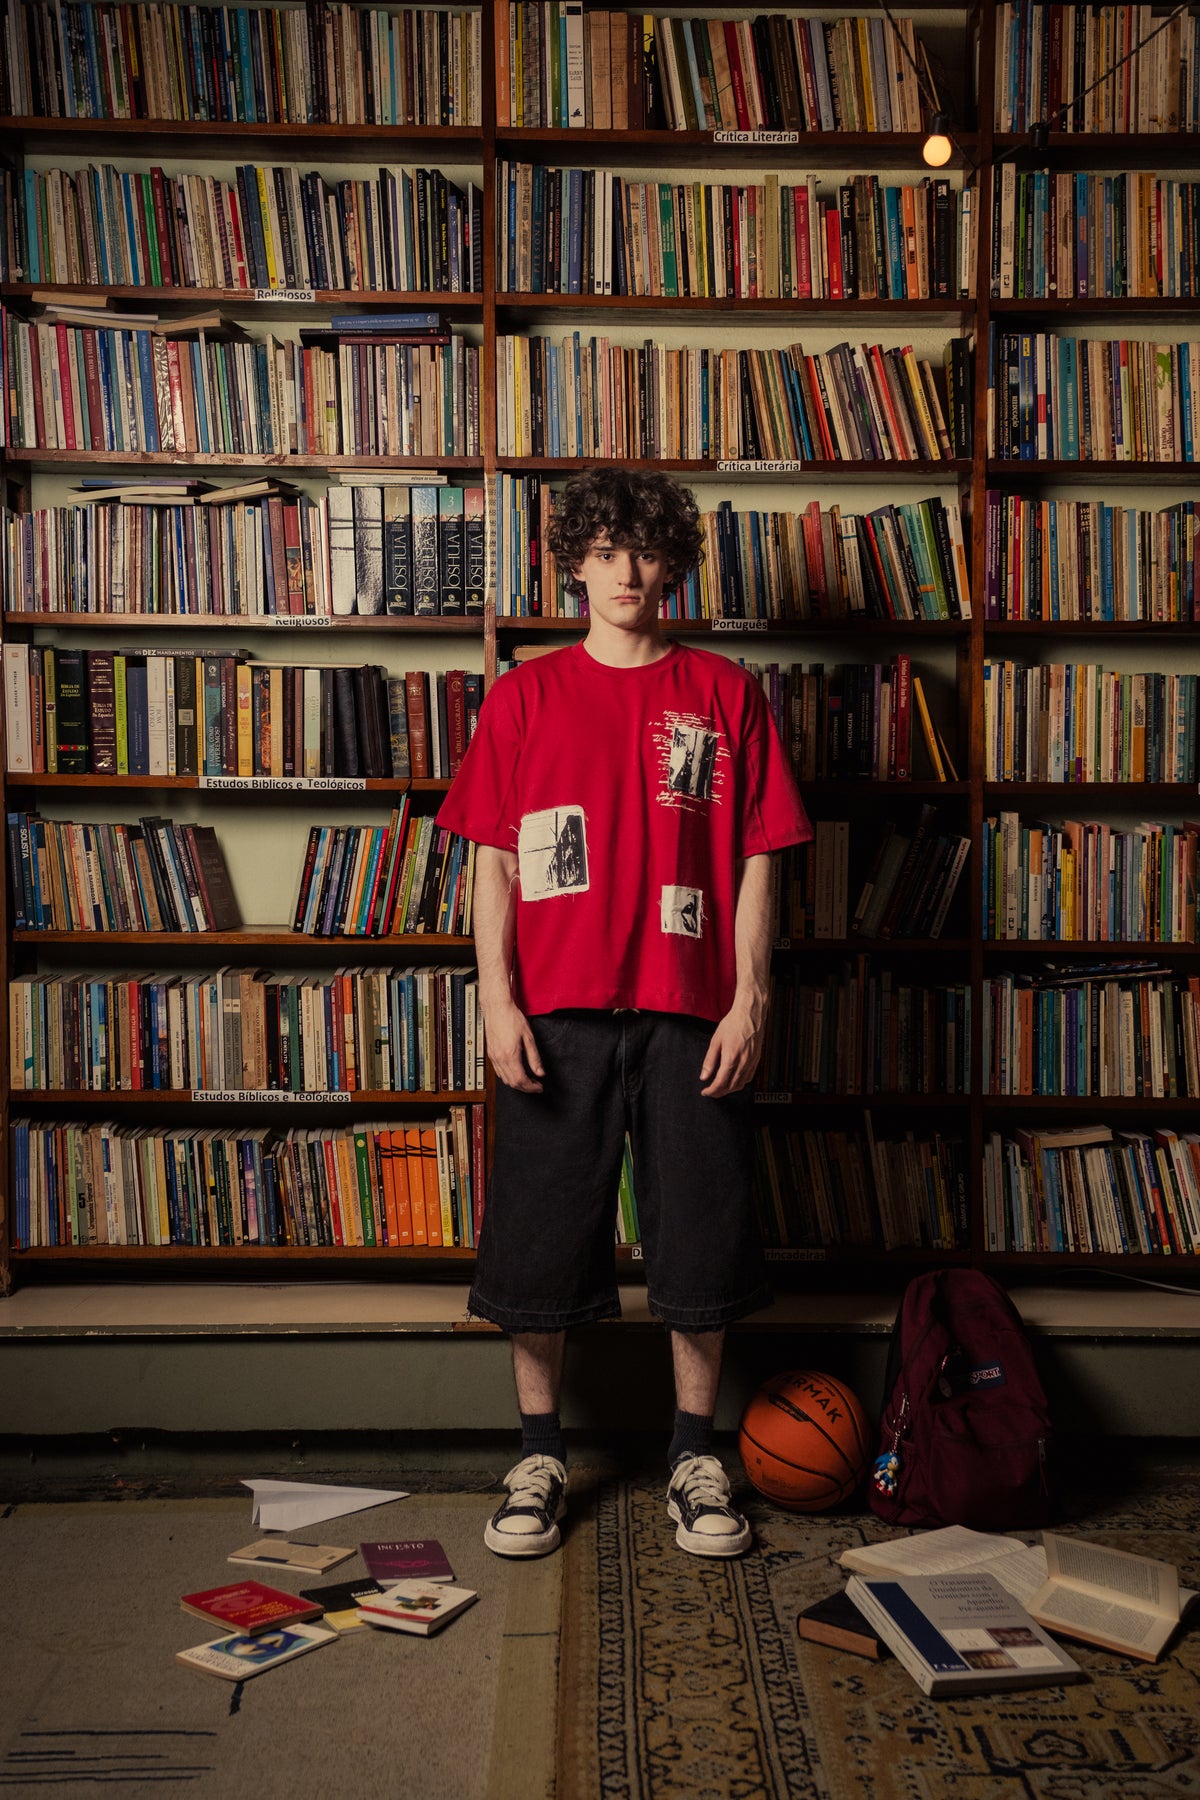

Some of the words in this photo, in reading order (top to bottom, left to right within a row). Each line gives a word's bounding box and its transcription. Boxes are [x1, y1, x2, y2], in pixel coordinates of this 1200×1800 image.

[714, 131, 749, 142] Crítica
[752, 130, 798, 142] Literária
[257, 289, 312, 301] Religiosos
[1166, 408, 1174, 444] Realidades
[717, 461, 751, 471] Crítica
[754, 461, 799, 471] Literária
[388, 534, 408, 591] JOSHUA
[417, 536, 436, 592] JOSHUA
[442, 534, 462, 590] JOSHUA
[464, 534, 484, 591] JOSHUA
[712, 619, 768, 631] Português
[846, 712, 854, 750] LINGUAGEM
[206, 778, 248, 789] Estudos
[252, 778, 293, 789] Bíblicos
[306, 778, 364, 790] Teológicos
[20, 828, 29, 859] SOLISTA
[192, 1091, 235, 1102] Estudos
[238, 1091, 280, 1102] Bíblicos
[282, 1094, 288, 1102] e
[293, 1091, 349, 1102] Teológicos
[376, 1542, 424, 1551] INCESTO
